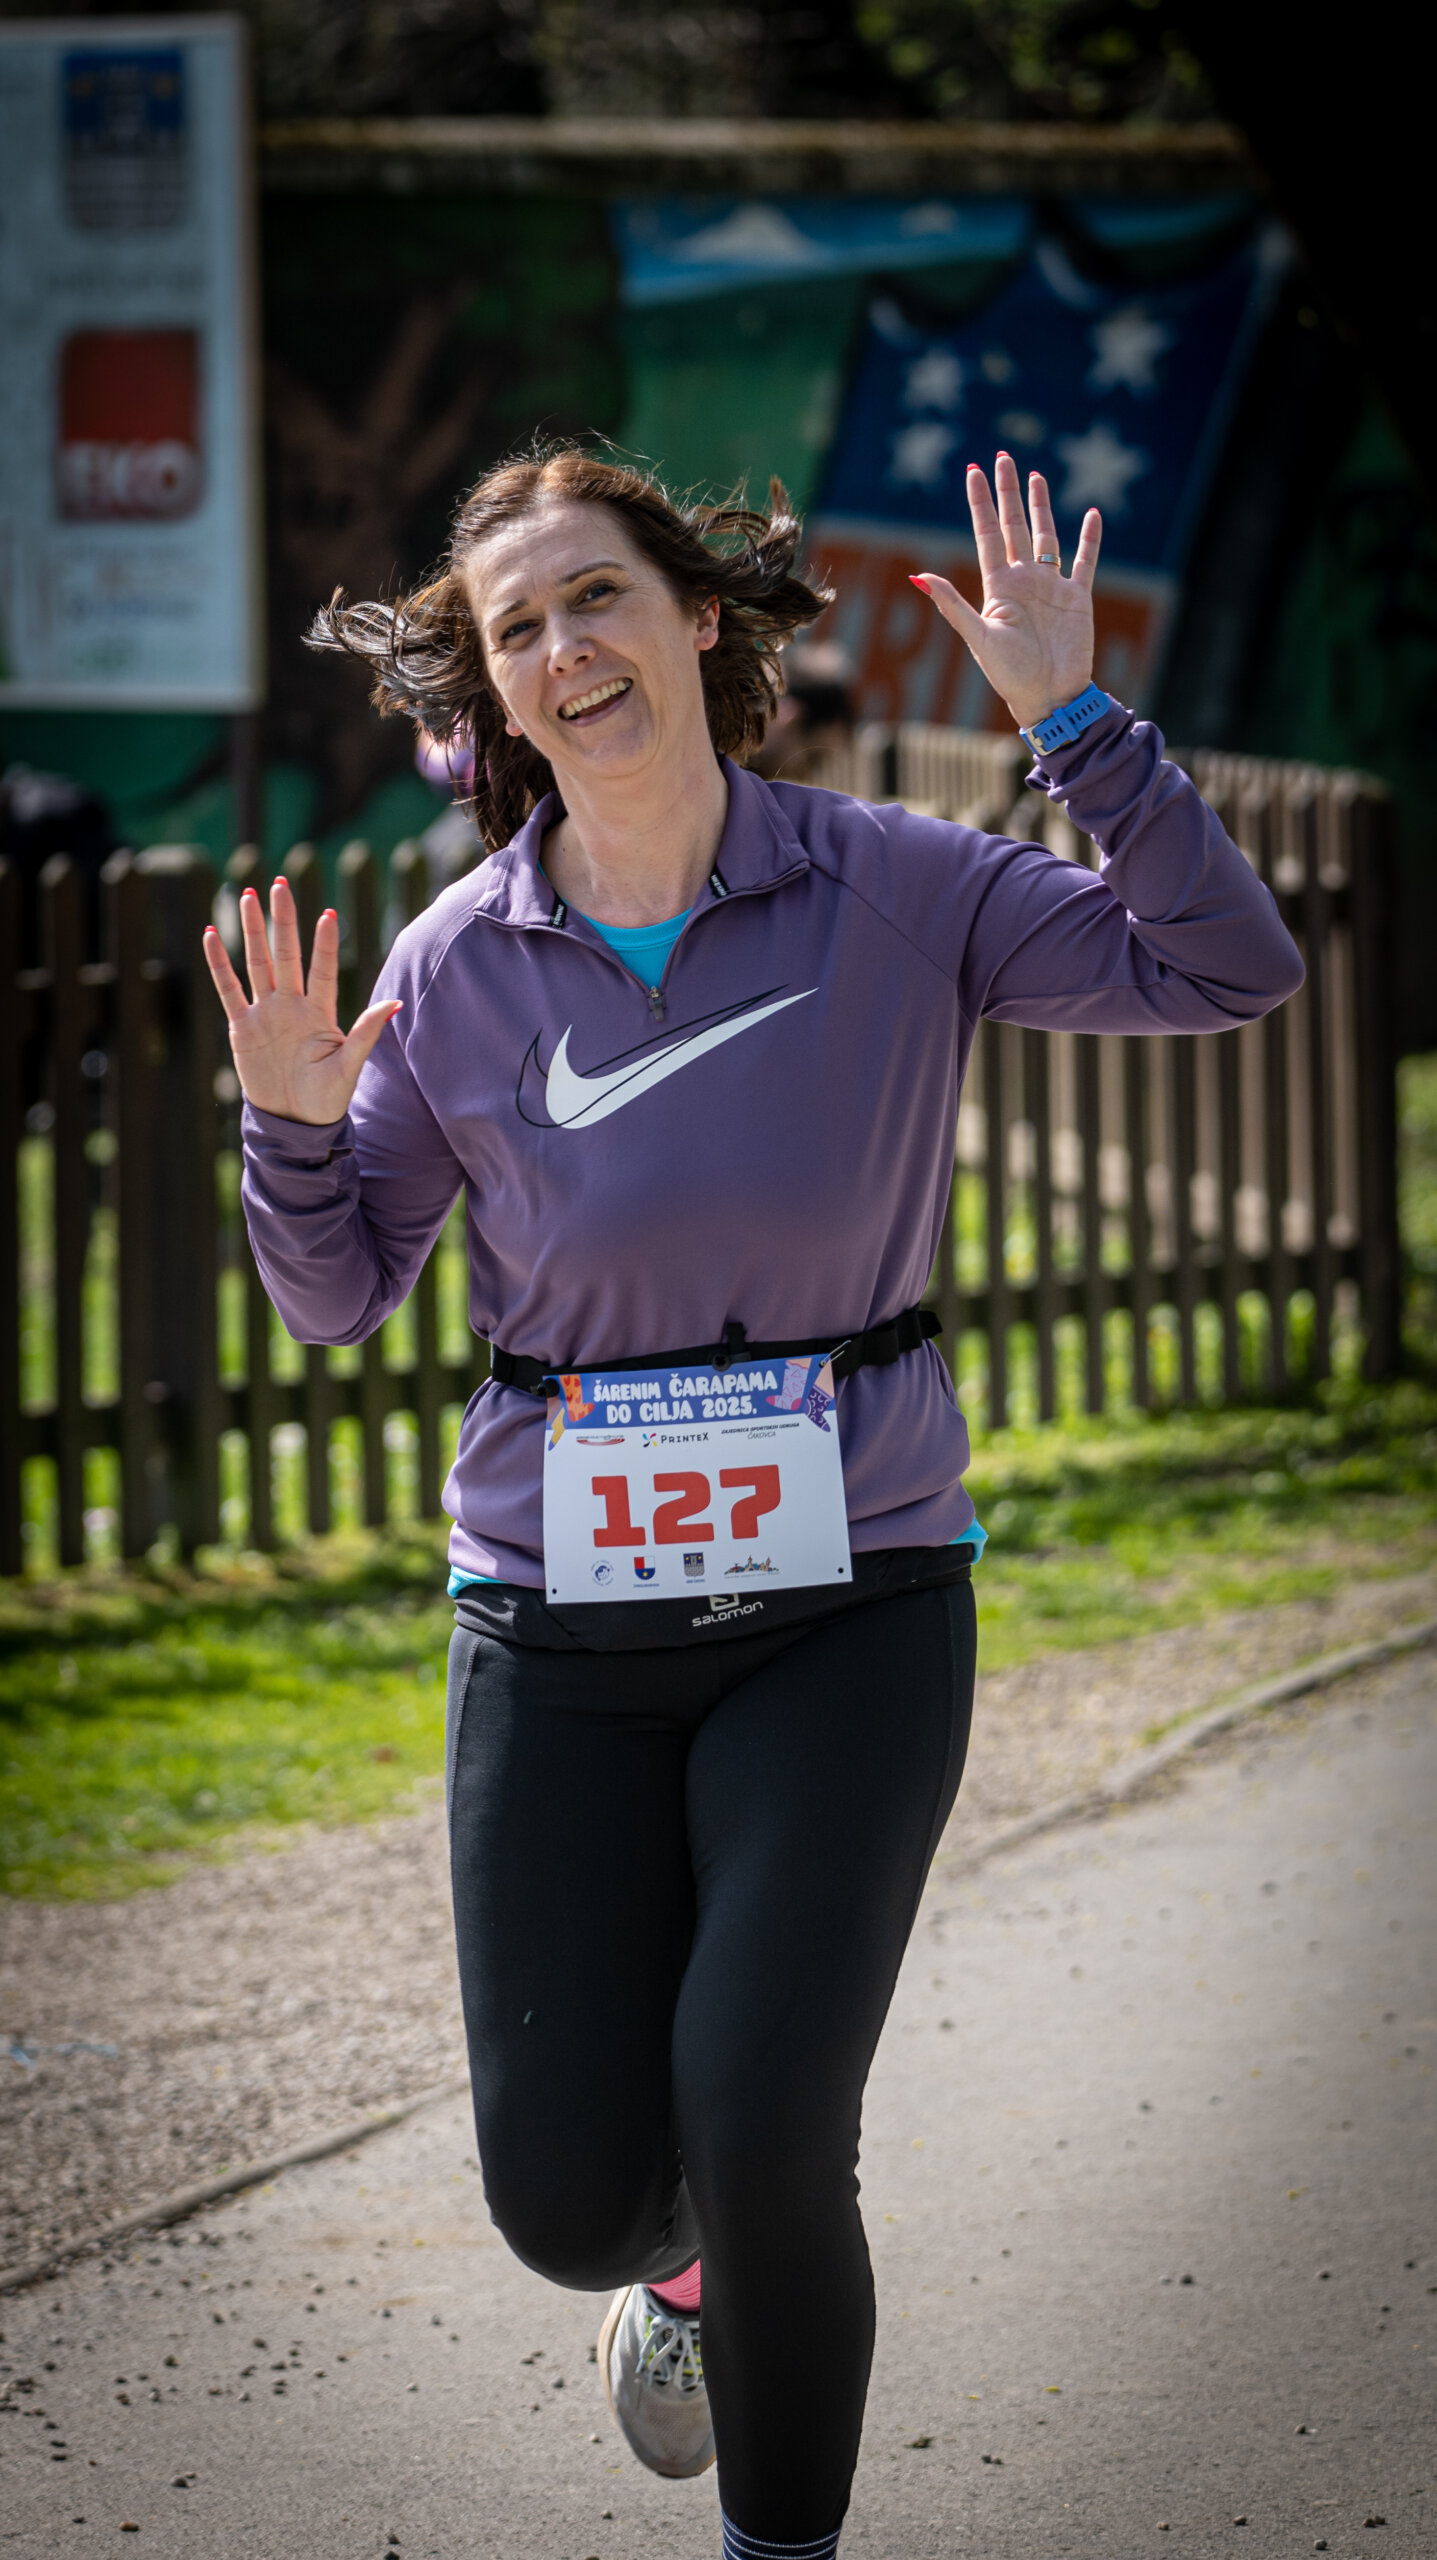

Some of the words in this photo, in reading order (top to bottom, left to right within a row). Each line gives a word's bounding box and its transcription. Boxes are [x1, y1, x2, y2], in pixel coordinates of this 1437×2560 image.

[593, 1379, 662, 1402] ŠARENIM
[668, 1373, 778, 1398] ČARAPAMA
[606, 1403, 632, 1424] DO
[639, 1400, 694, 1422] CILJA
[701, 1395, 758, 1418] 2025.
[591, 1464, 781, 1548] 127
